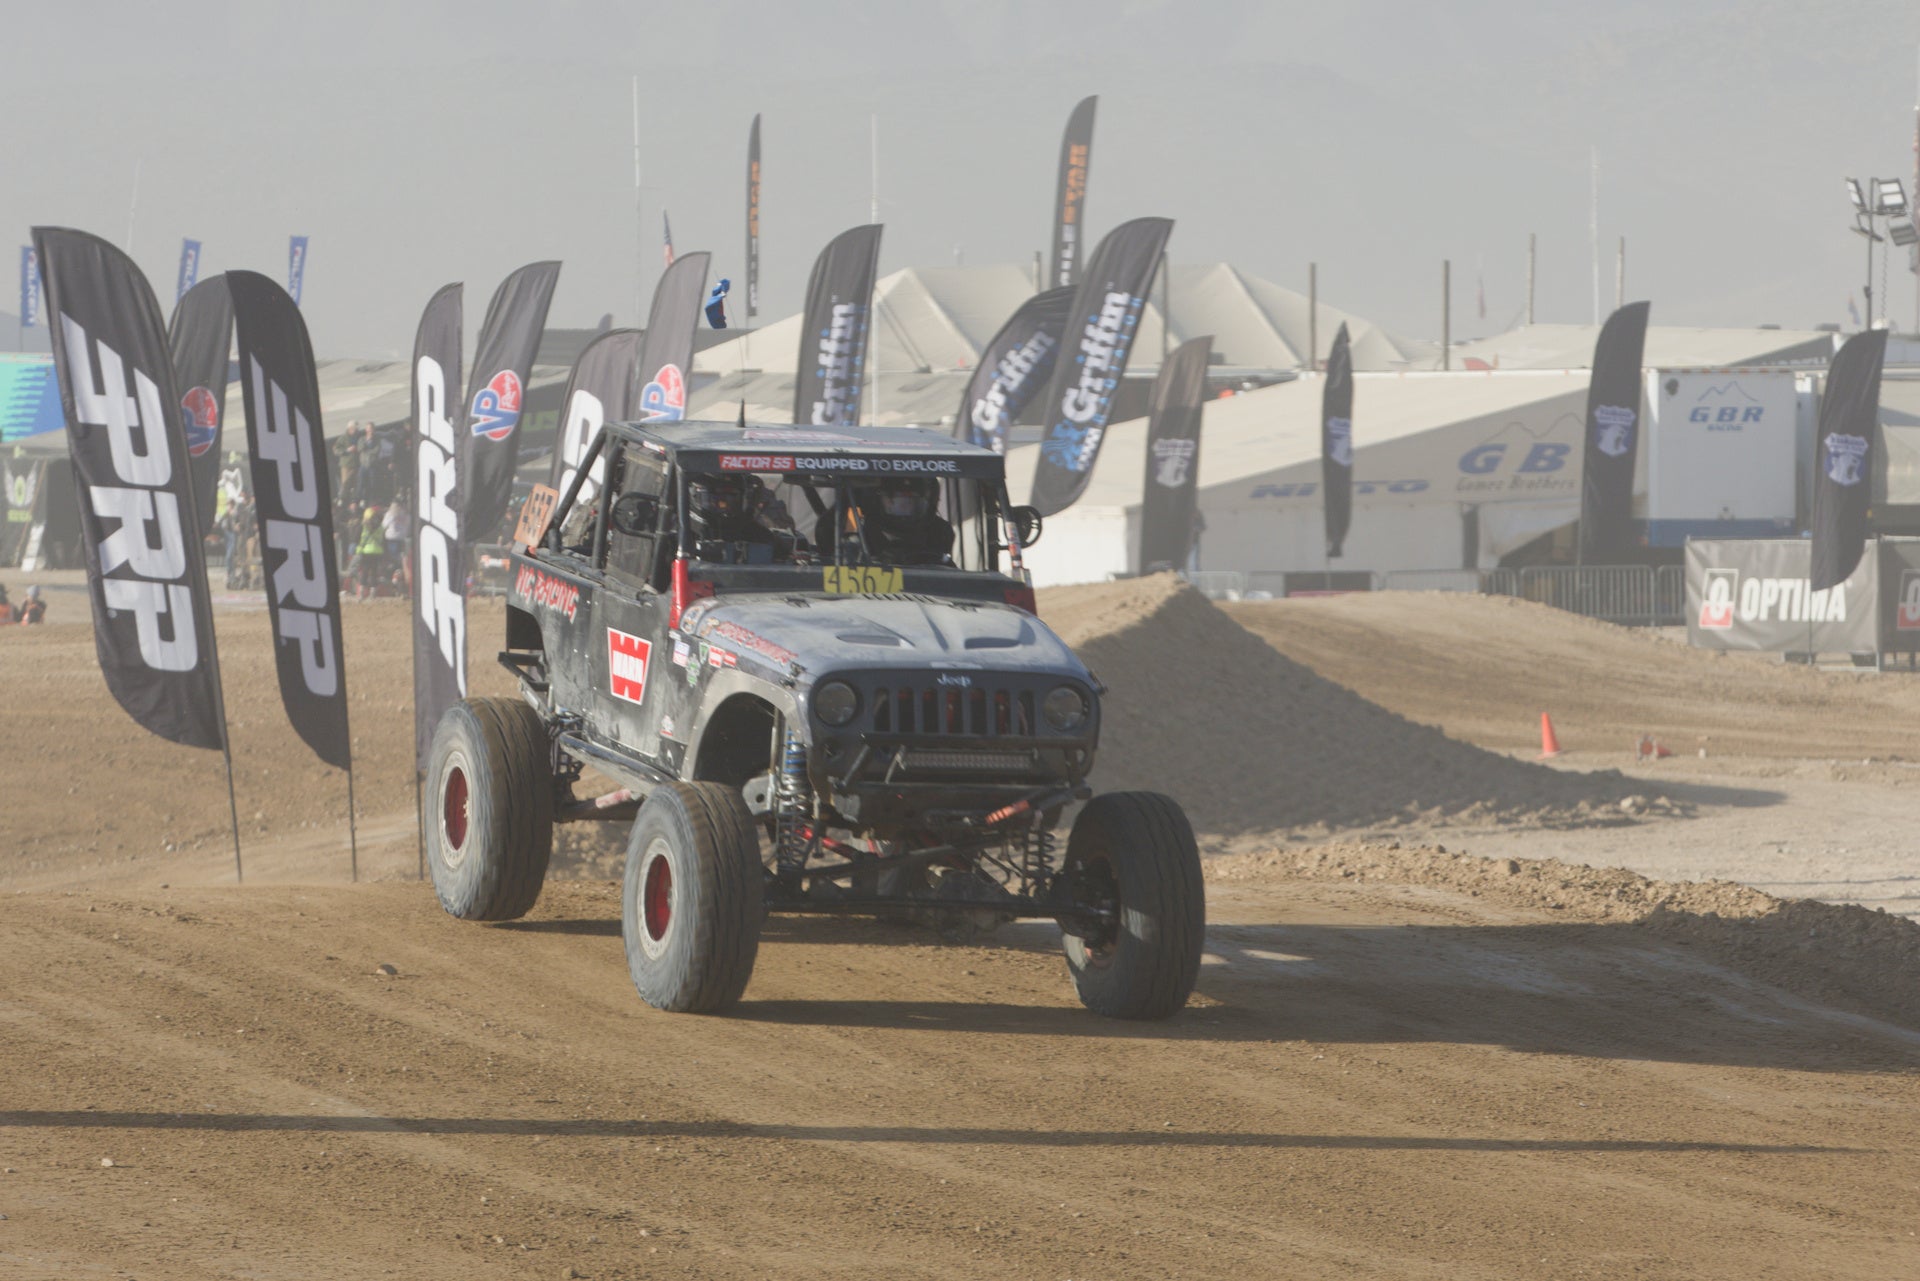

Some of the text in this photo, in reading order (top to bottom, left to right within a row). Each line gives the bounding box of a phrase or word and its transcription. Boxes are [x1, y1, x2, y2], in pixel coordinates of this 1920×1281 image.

[972, 330, 1055, 431] Griffin
[1062, 291, 1131, 423] Griffin
[471, 388, 518, 437] VP
[720, 455, 770, 469] FACTOR
[771, 456, 792, 469] 55
[795, 457, 869, 471] EQUIPPED
[870, 459, 892, 472] TO
[60, 311, 198, 672] PRP
[250, 352, 338, 697] PRP
[418, 355, 467, 697] PRP
[828, 566, 897, 593] 4567
[1740, 576, 1847, 622] OPTIMA
[612, 650, 645, 685] WARN
[936, 672, 973, 687] Jeep
